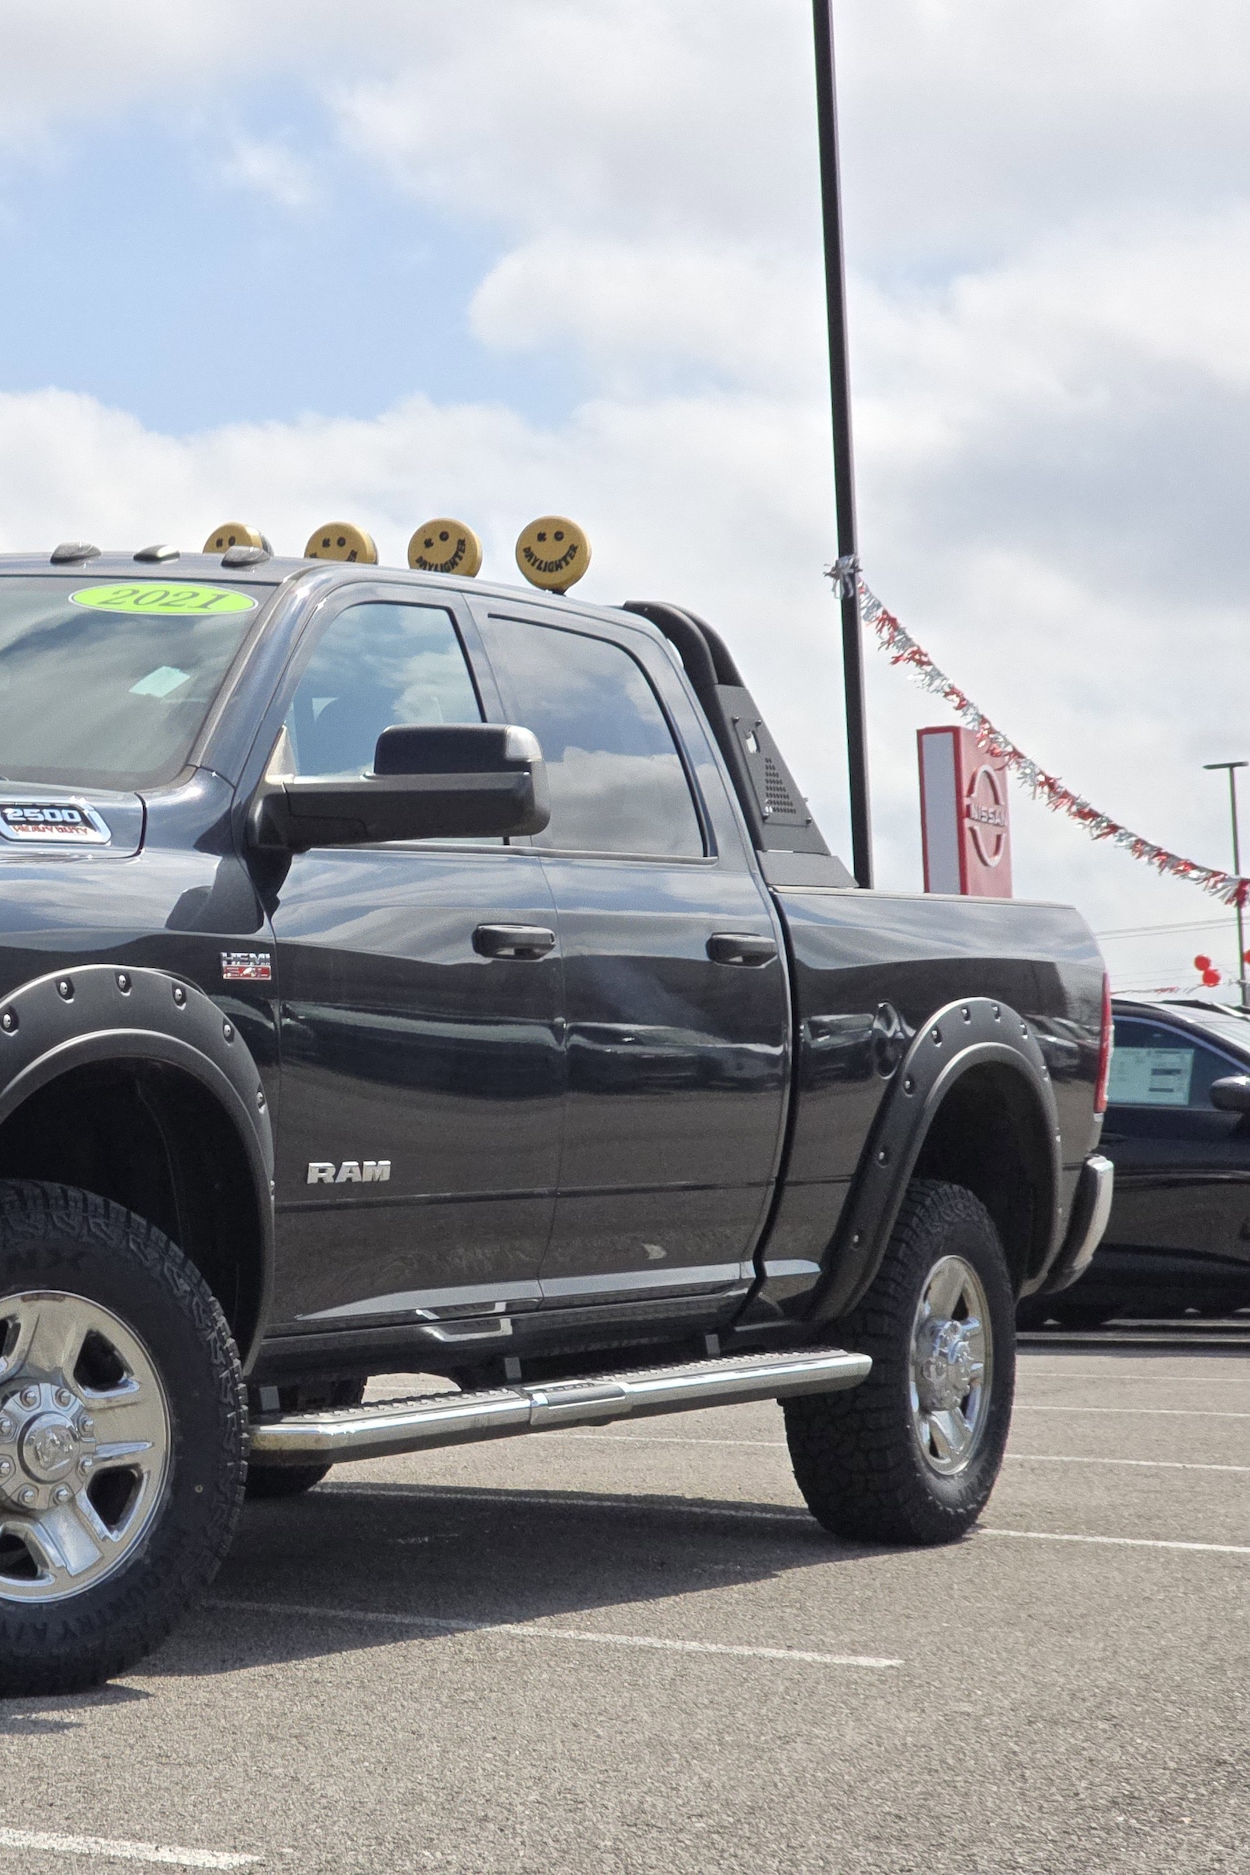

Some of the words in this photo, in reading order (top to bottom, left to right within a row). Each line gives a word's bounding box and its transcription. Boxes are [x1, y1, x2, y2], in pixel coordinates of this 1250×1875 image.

[523, 543, 578, 573] DAYLIGHTER
[97, 588, 230, 610] 2021
[4, 807, 82, 823] 2500
[971, 803, 1005, 826] NISSAN
[221, 952, 270, 966] HEMI
[306, 1160, 391, 1184] RAM
